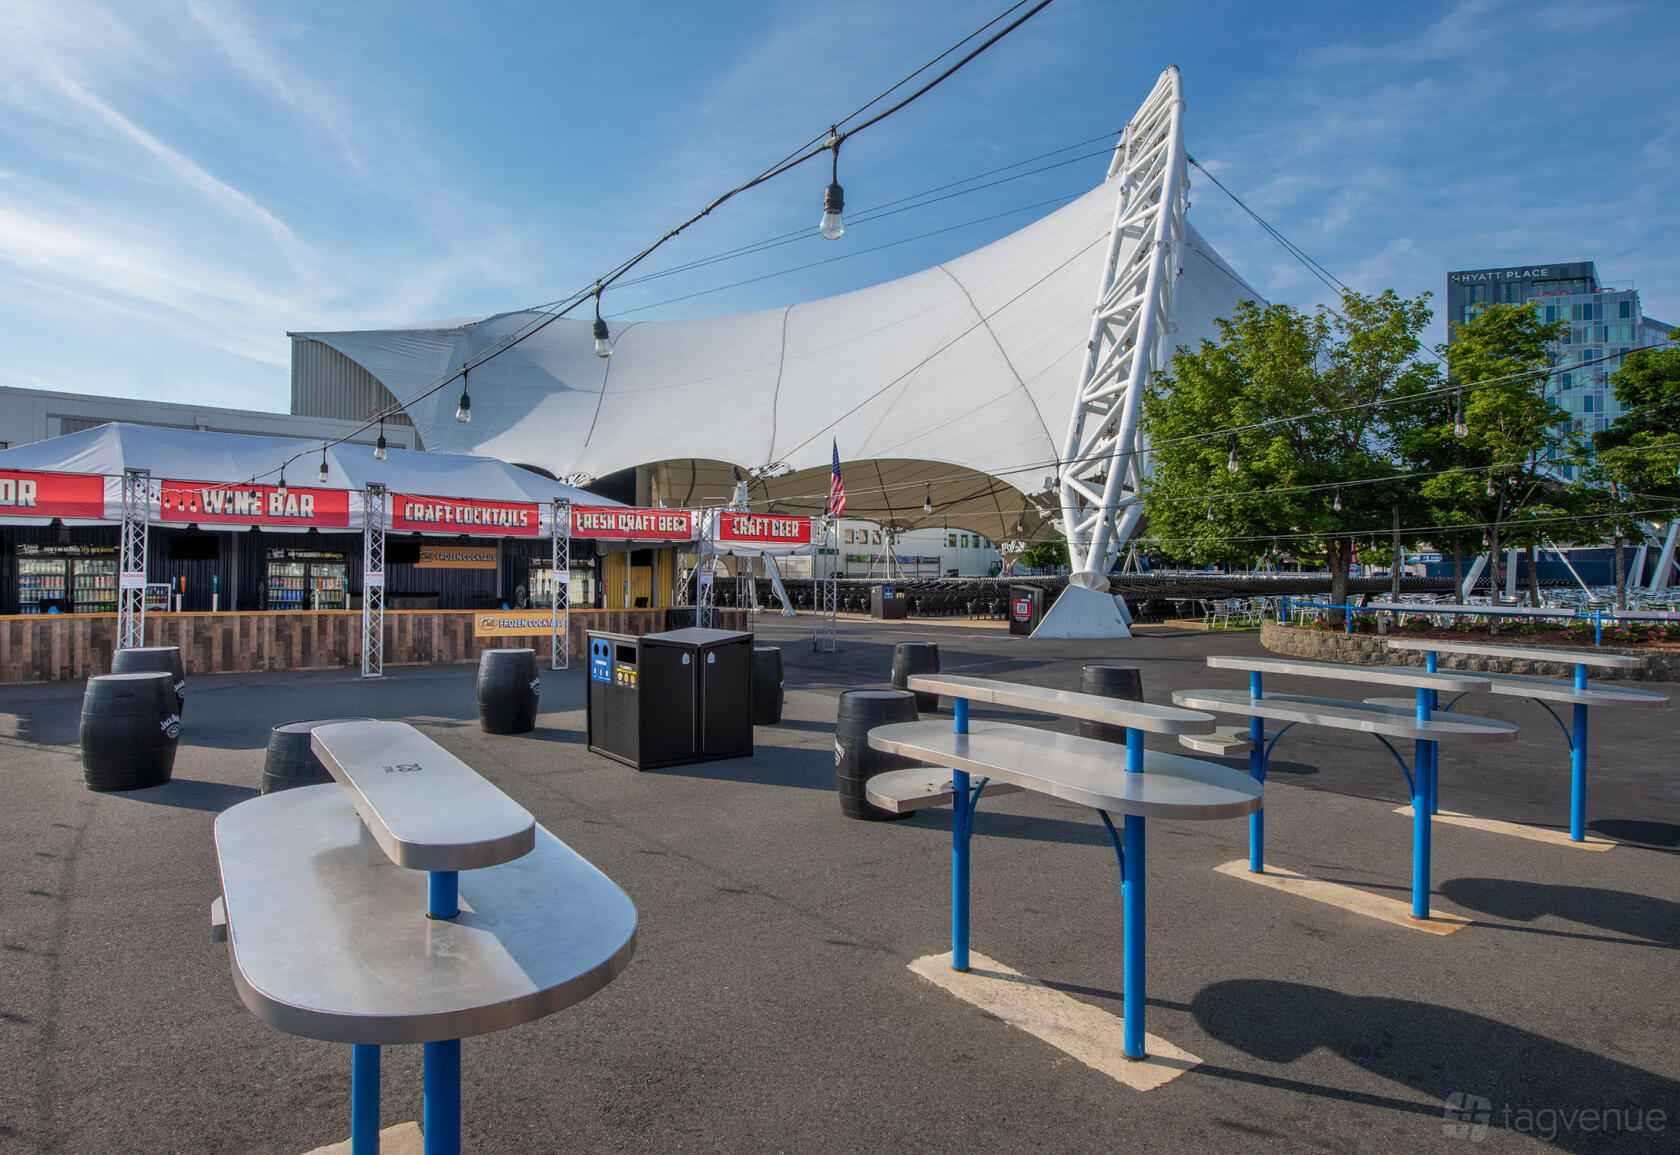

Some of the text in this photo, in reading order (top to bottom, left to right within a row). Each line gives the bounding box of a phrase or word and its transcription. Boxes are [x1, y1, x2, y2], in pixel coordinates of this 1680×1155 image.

[1462, 268, 1548, 282] HYATT PLACE
[201, 489, 315, 518] WINE BAR
[404, 503, 528, 527] CRAFT COCKTAILS
[576, 512, 687, 532] FRESH DRAFT BEER
[733, 517, 799, 537] CRAFT BEER
[436, 553, 461, 561] FROZEN
[462, 554, 496, 562] COCKTAILS
[499, 619, 526, 628] FROZEN
